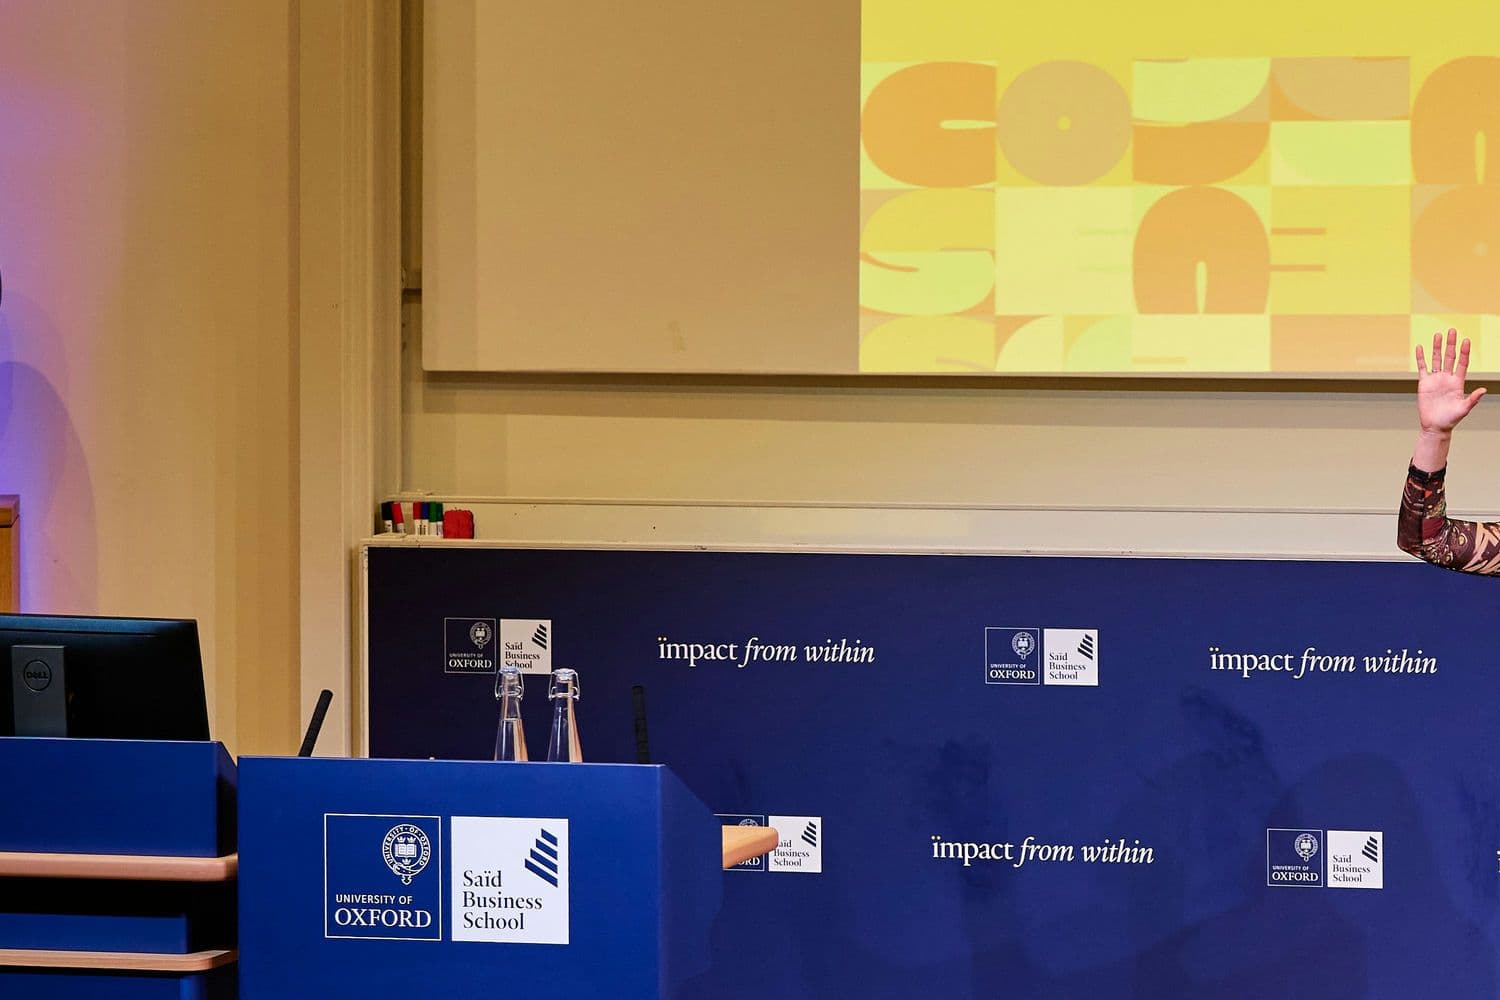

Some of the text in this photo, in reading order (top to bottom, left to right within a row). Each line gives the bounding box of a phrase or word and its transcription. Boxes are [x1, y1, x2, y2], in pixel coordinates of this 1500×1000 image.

[505, 651, 540, 659] Business
[738, 637, 797, 668] from
[804, 639, 875, 663] within
[449, 659, 492, 668] OXFORD
[1049, 662, 1086, 670] Business
[1294, 647, 1356, 679] from
[1362, 649, 1437, 674] within
[990, 670, 1035, 679] OXFORD
[1049, 672, 1077, 680] School
[1013, 836, 1074, 867] from
[1081, 839, 1154, 864] within
[1333, 864, 1370, 873] Business
[463, 870, 502, 888] Saïd
[1272, 872, 1318, 881] OXFORD
[1333, 874, 1362, 882] School
[335, 894, 413, 905] UNIVERSITY OF
[463, 891, 542, 910] Business
[335, 908, 432, 928] OXFORD
[463, 912, 524, 930] School
